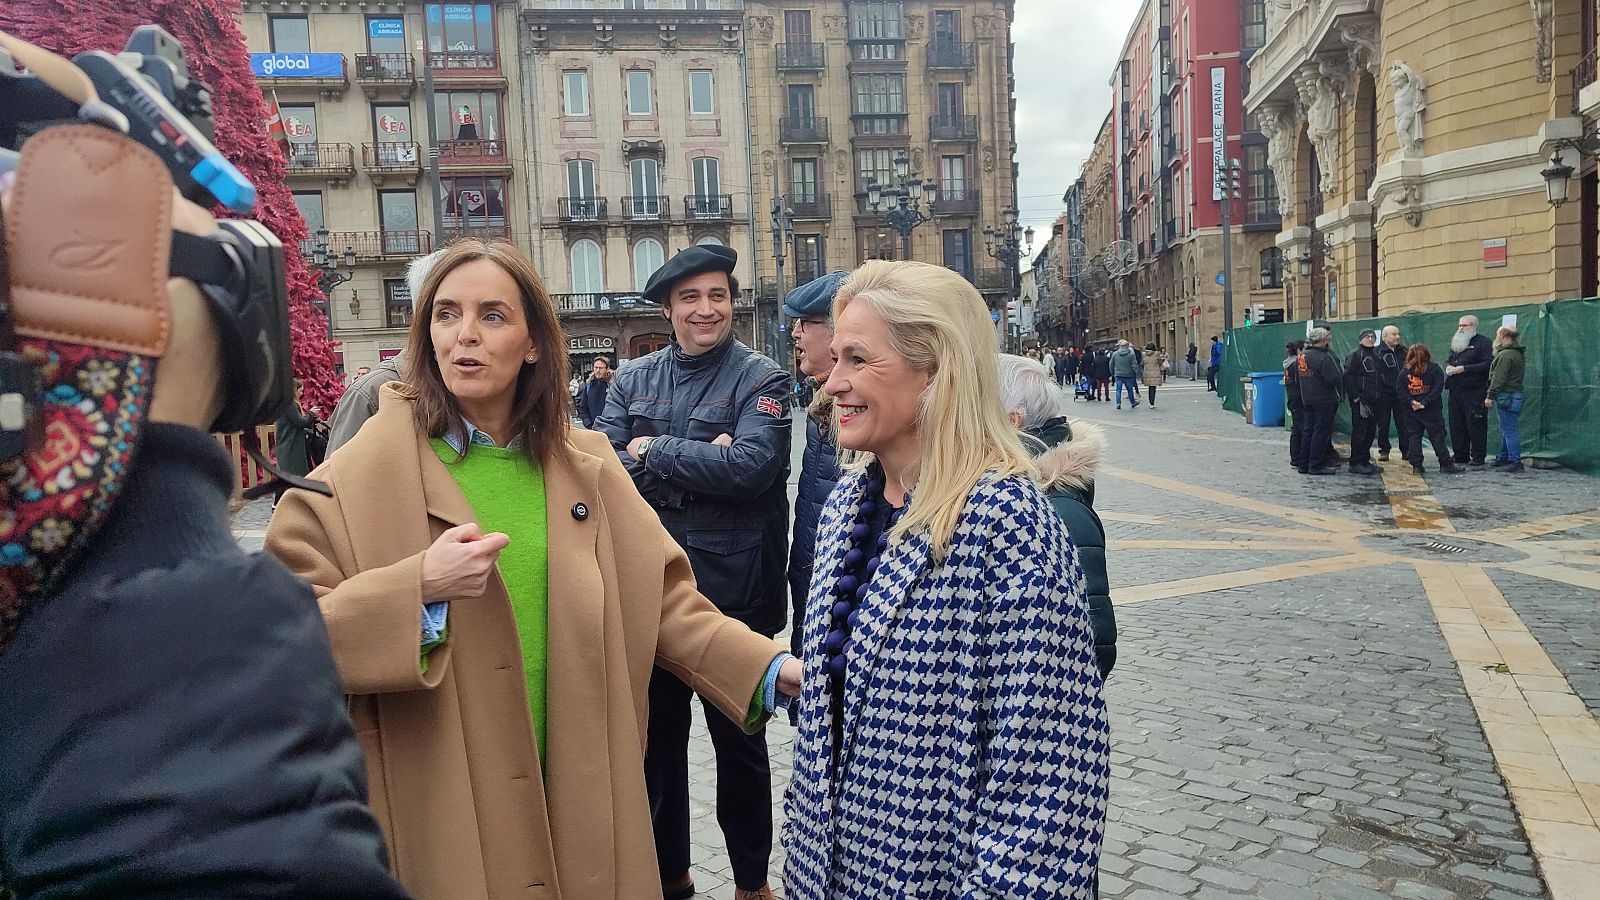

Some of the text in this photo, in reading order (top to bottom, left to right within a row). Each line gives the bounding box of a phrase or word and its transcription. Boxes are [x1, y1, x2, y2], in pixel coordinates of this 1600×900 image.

[262, 55, 310, 75] global
[1214, 82, 1223, 116] ARANA
[570, 338, 612, 349] EL TILO
